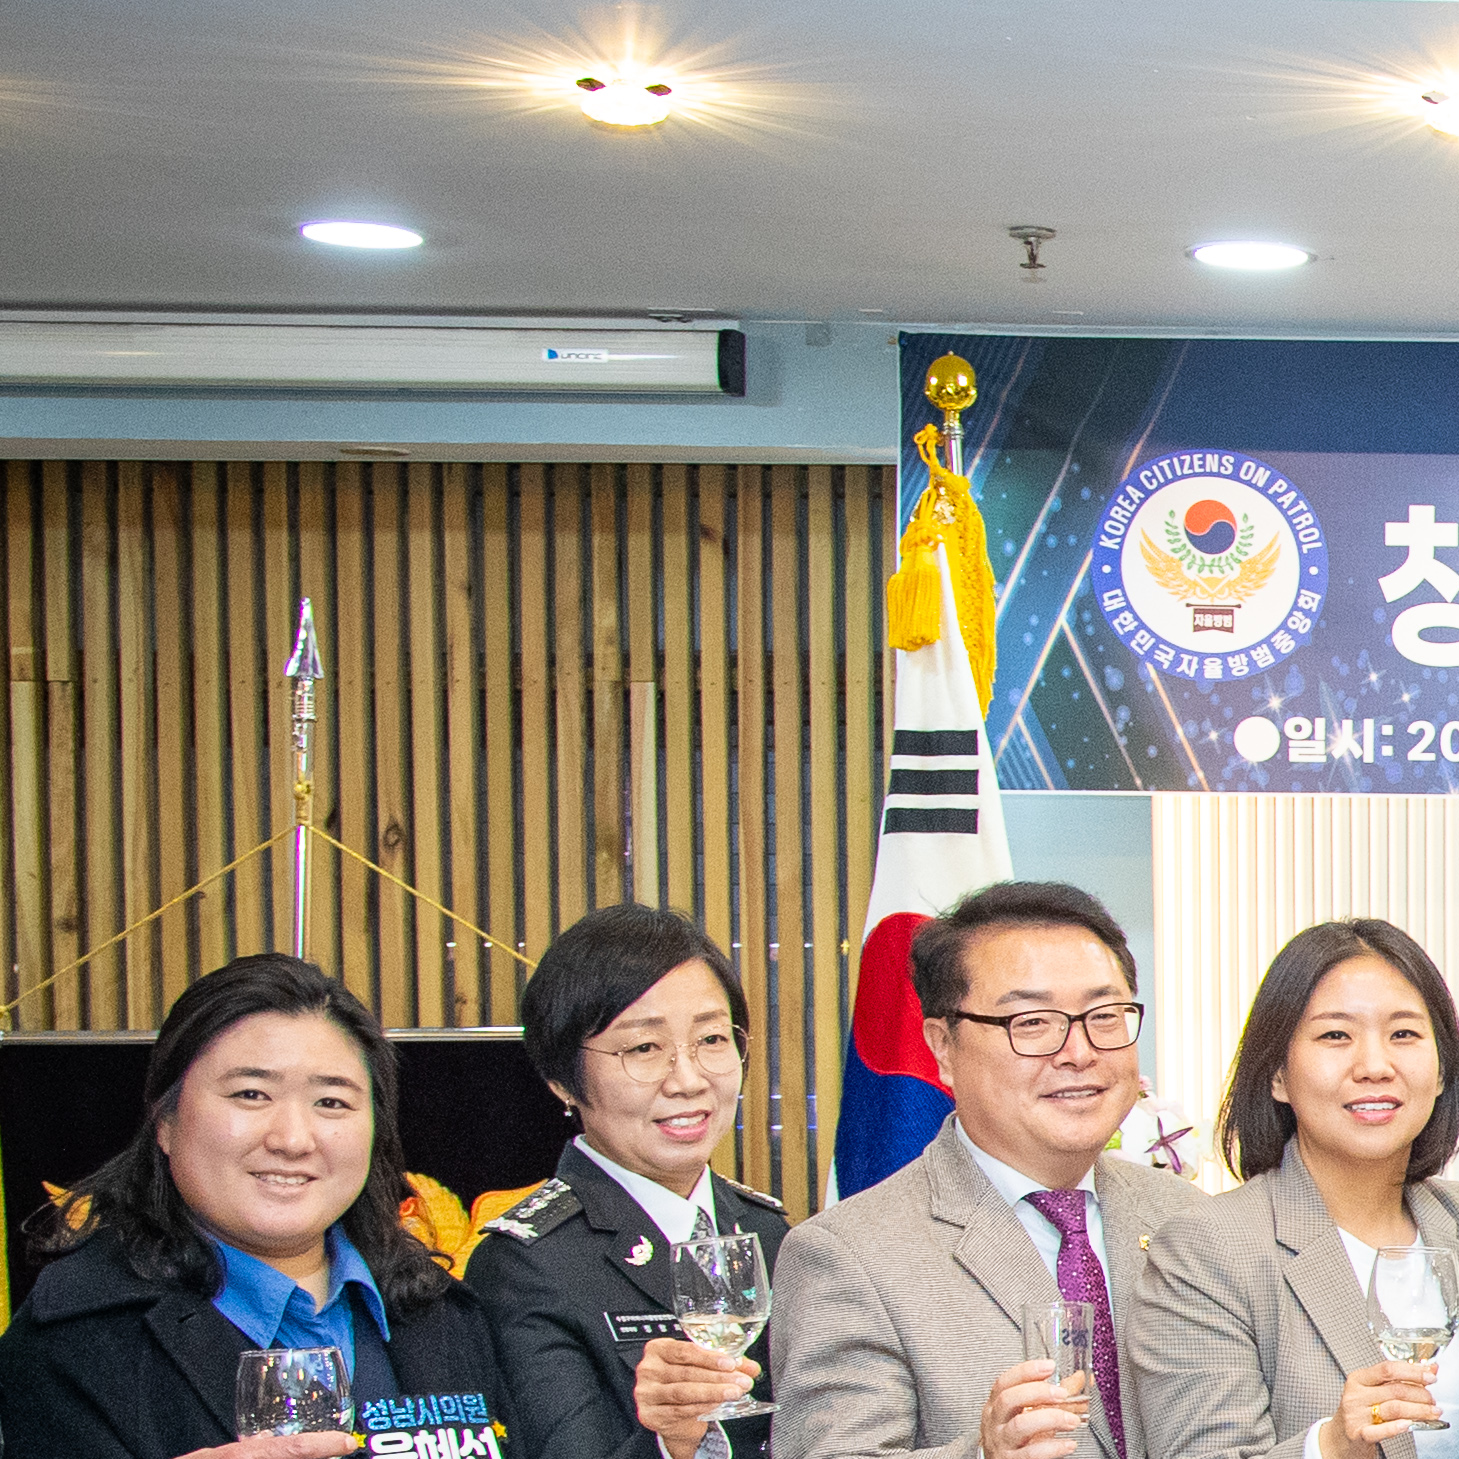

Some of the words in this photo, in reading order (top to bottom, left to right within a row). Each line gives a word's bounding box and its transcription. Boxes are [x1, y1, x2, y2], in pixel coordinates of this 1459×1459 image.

[1099, 485, 1145, 550] KOREA
[1139, 453, 1235, 490] CITIZENS
[1239, 461, 1271, 488] ON
[1267, 479, 1323, 554] PATROL
[1193, 612, 1234, 629] 자율방범
[1284, 716, 1393, 767] 일시:
[362, 1393, 489, 1430] 성남시의원
